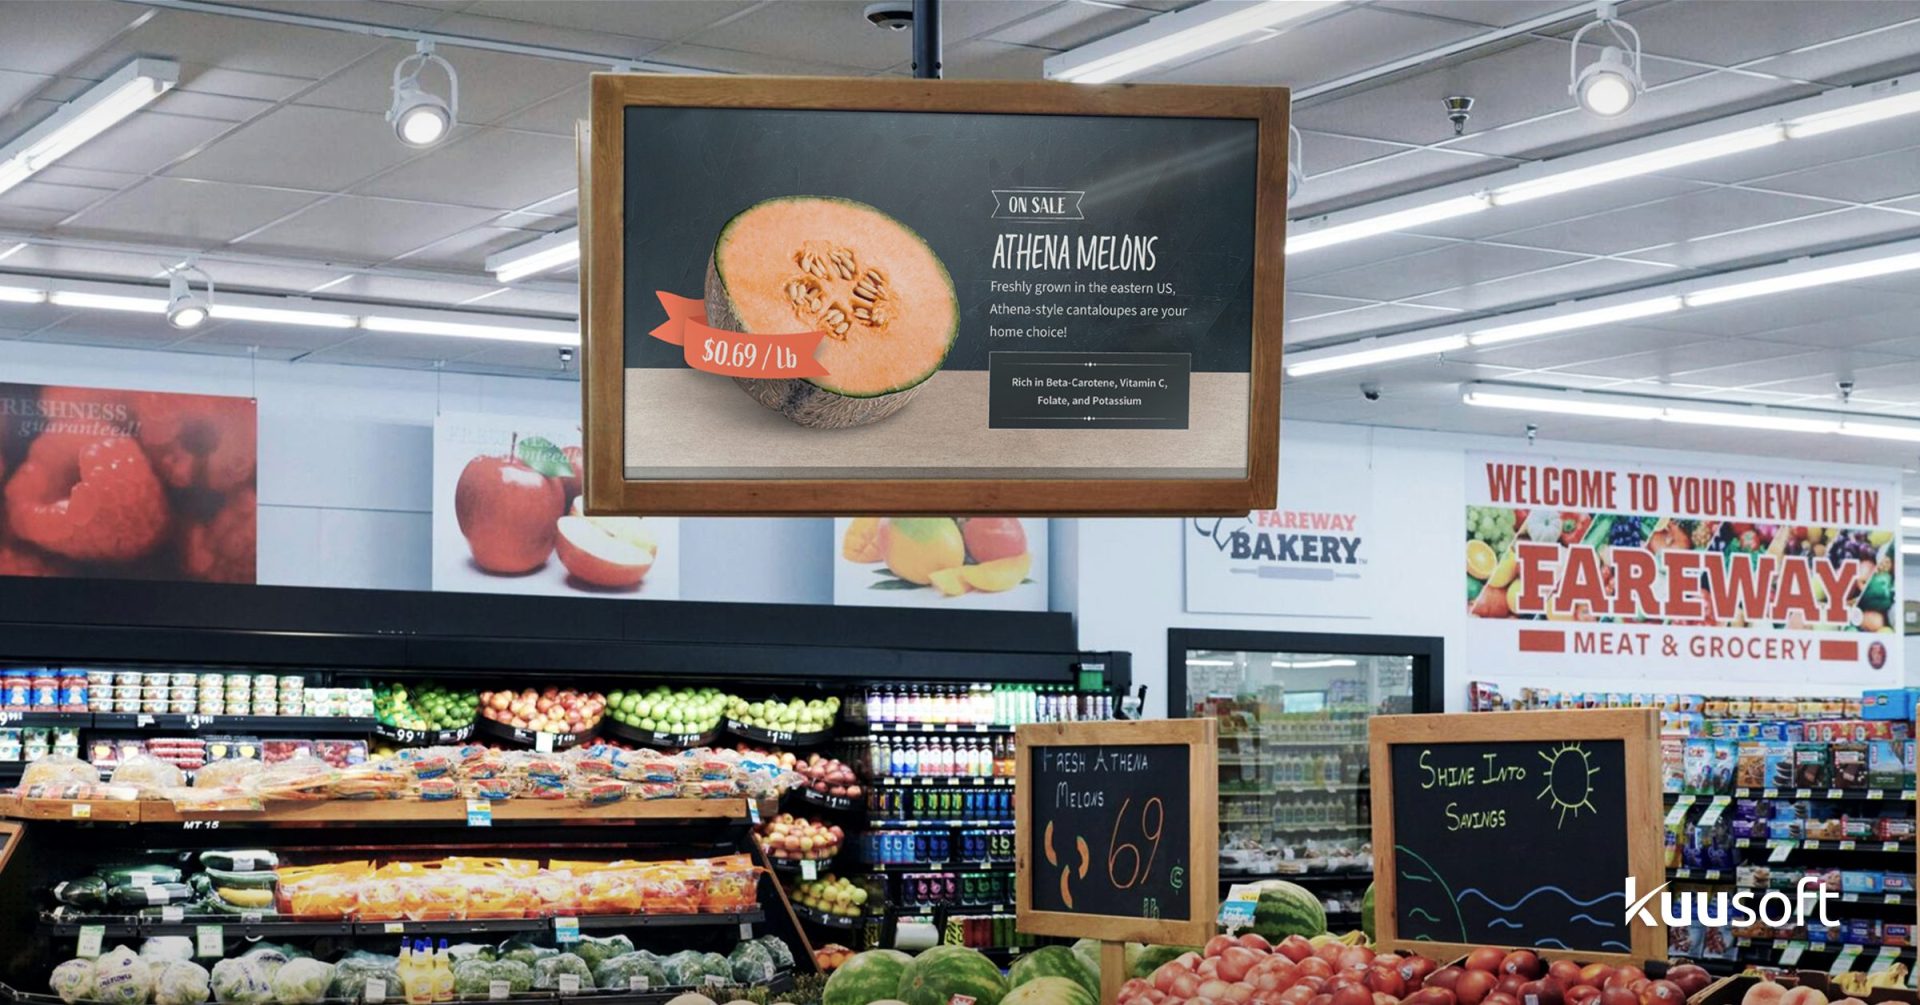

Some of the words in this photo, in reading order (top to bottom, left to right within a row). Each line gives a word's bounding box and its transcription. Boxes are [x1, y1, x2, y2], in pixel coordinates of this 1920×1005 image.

[1008, 196, 1027, 213] ON
[1031, 197, 1066, 214] SALE
[992, 233, 1070, 271] ATHENA
[1077, 234, 1158, 272] MELONS
[990, 281, 1032, 295] Freshly
[1035, 283, 1071, 296] grown
[1074, 281, 1085, 293] in
[1089, 282, 1107, 293] the
[1110, 283, 1153, 294] eastern
[1157, 283, 1176, 296] US,
[990, 303, 1063, 318] Athena-style
[1066, 305, 1137, 319] cantaloupes
[1140, 307, 1158, 317] are
[1161, 307, 1188, 319] your
[990, 326, 1023, 338] home
[1026, 326, 1067, 338] choice!
[701, 337, 757, 368] $0.69
[776, 345, 797, 369] lb
[1011, 378, 1032, 387] Rich
[1035, 378, 1044, 387] in
[1046, 378, 1118, 390] Beta-Carotene,
[1120, 378, 1156, 388] Vitamin
[1158, 379, 1168, 390] C,
[1037, 396, 1070, 407] Folate,
[1072, 396, 1090, 406] and
[1092, 396, 1142, 406] Potassium
[19, 420, 141, 437] guaranteed!
[1486, 462, 1617, 510] WELCOME
[1627, 472, 1658, 512] TO
[1668, 476, 1736, 518] YOUR
[1747, 481, 1799, 521] NEW
[1808, 485, 1880, 526] TIFFIN
[1257, 510, 1357, 532] FAREWAY
[1230, 531, 1362, 565] BAKERY
[1517, 544, 1860, 625] FAREWAY
[1573, 632, 1650, 656] MEAT
[1661, 635, 1679, 657] &
[1689, 635, 1813, 661] GROCERY
[1419, 749, 1475, 789] SHINE
[1482, 753, 1527, 785] INTO
[183, 820, 203, 829] MT
[204, 820, 220, 829] 15
[1445, 802, 1507, 831] SAVINGS
[1108, 797, 1164, 889] 69
